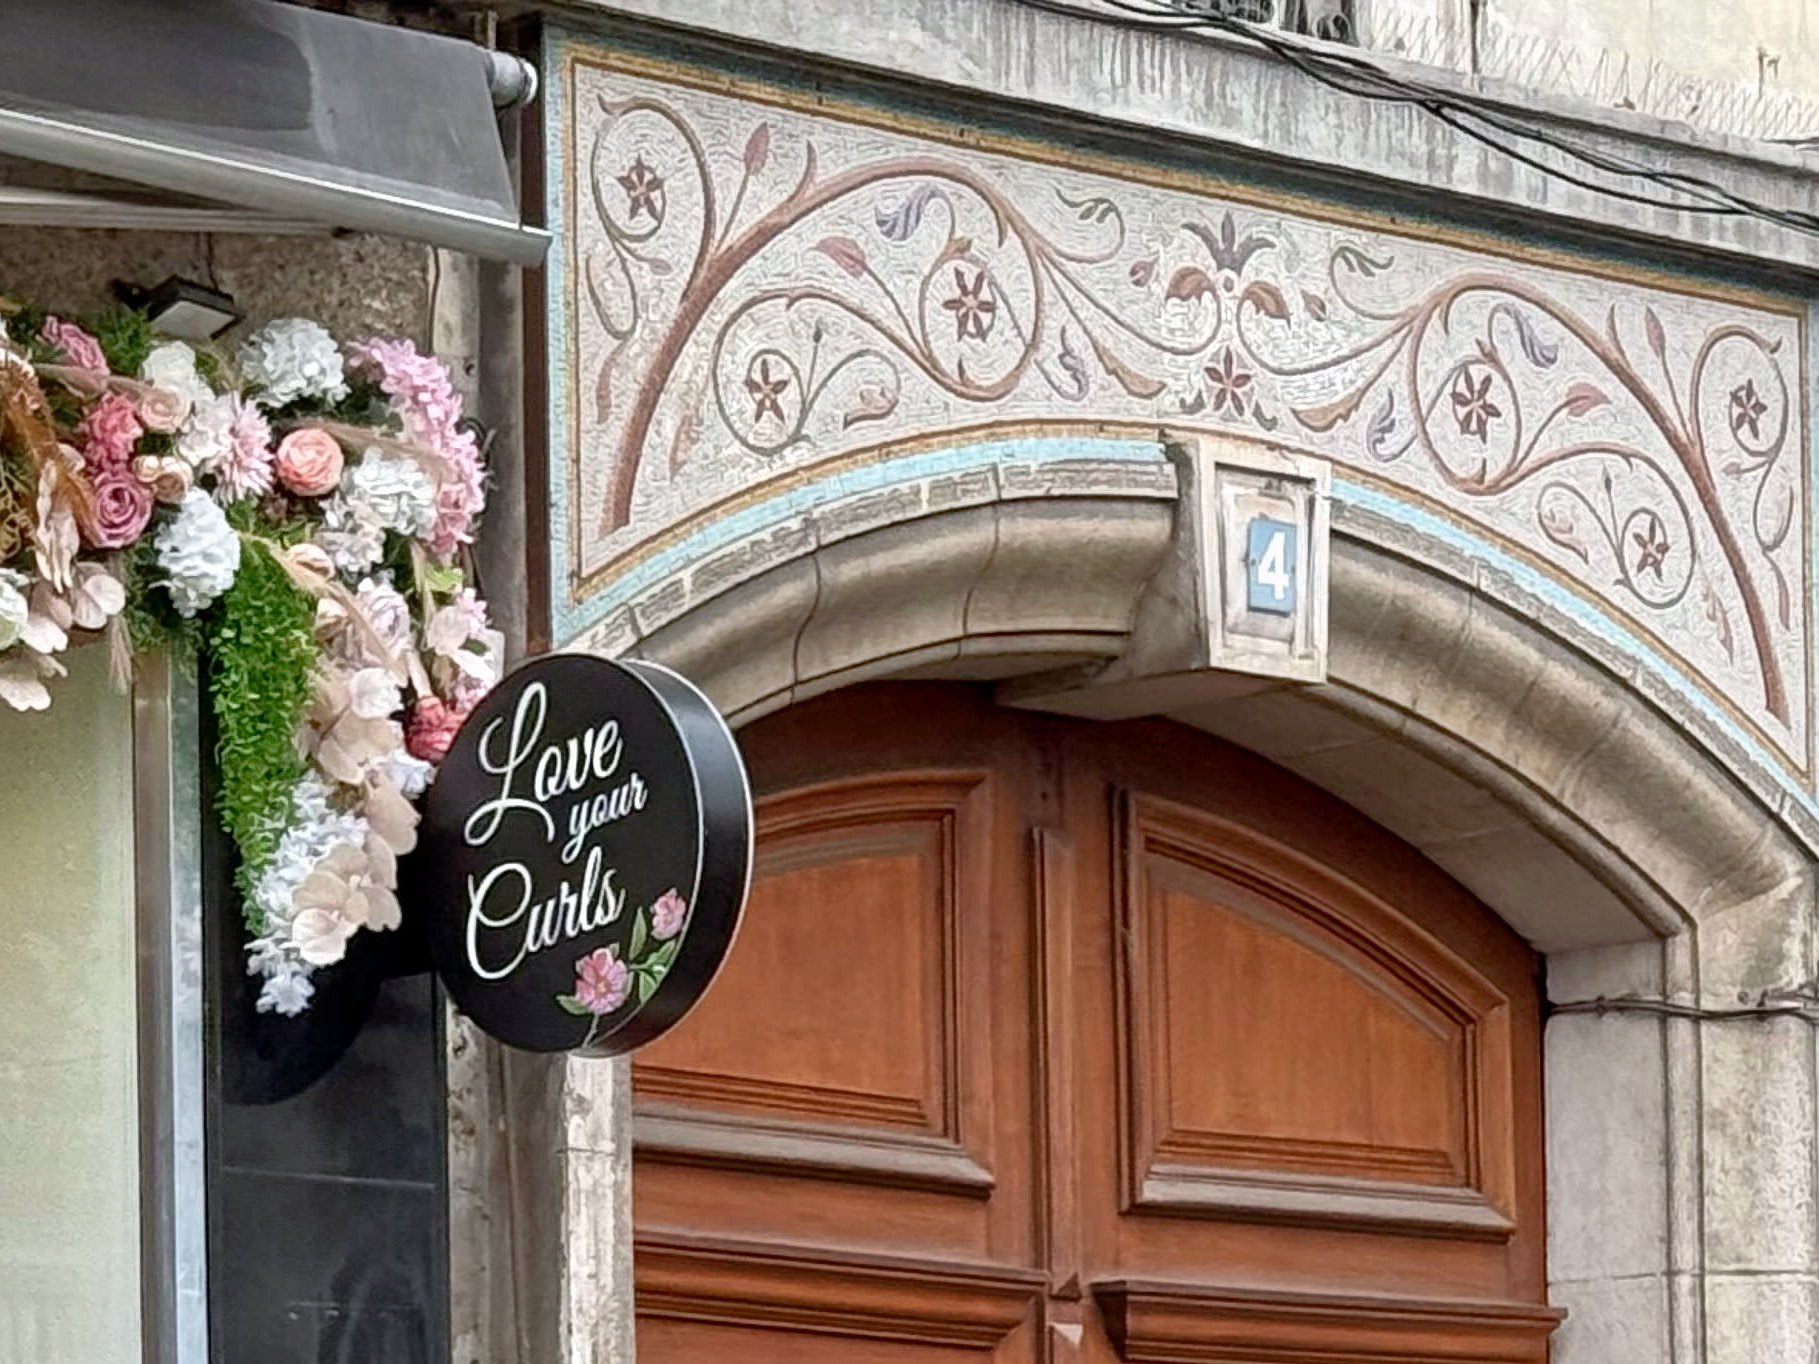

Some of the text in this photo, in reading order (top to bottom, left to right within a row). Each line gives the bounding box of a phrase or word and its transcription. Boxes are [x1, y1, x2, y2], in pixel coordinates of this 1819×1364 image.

[1258, 531, 1290, 600] 4
[464, 681, 624, 847] Love
[561, 771, 649, 865] your
[467, 846, 626, 979] Curls
